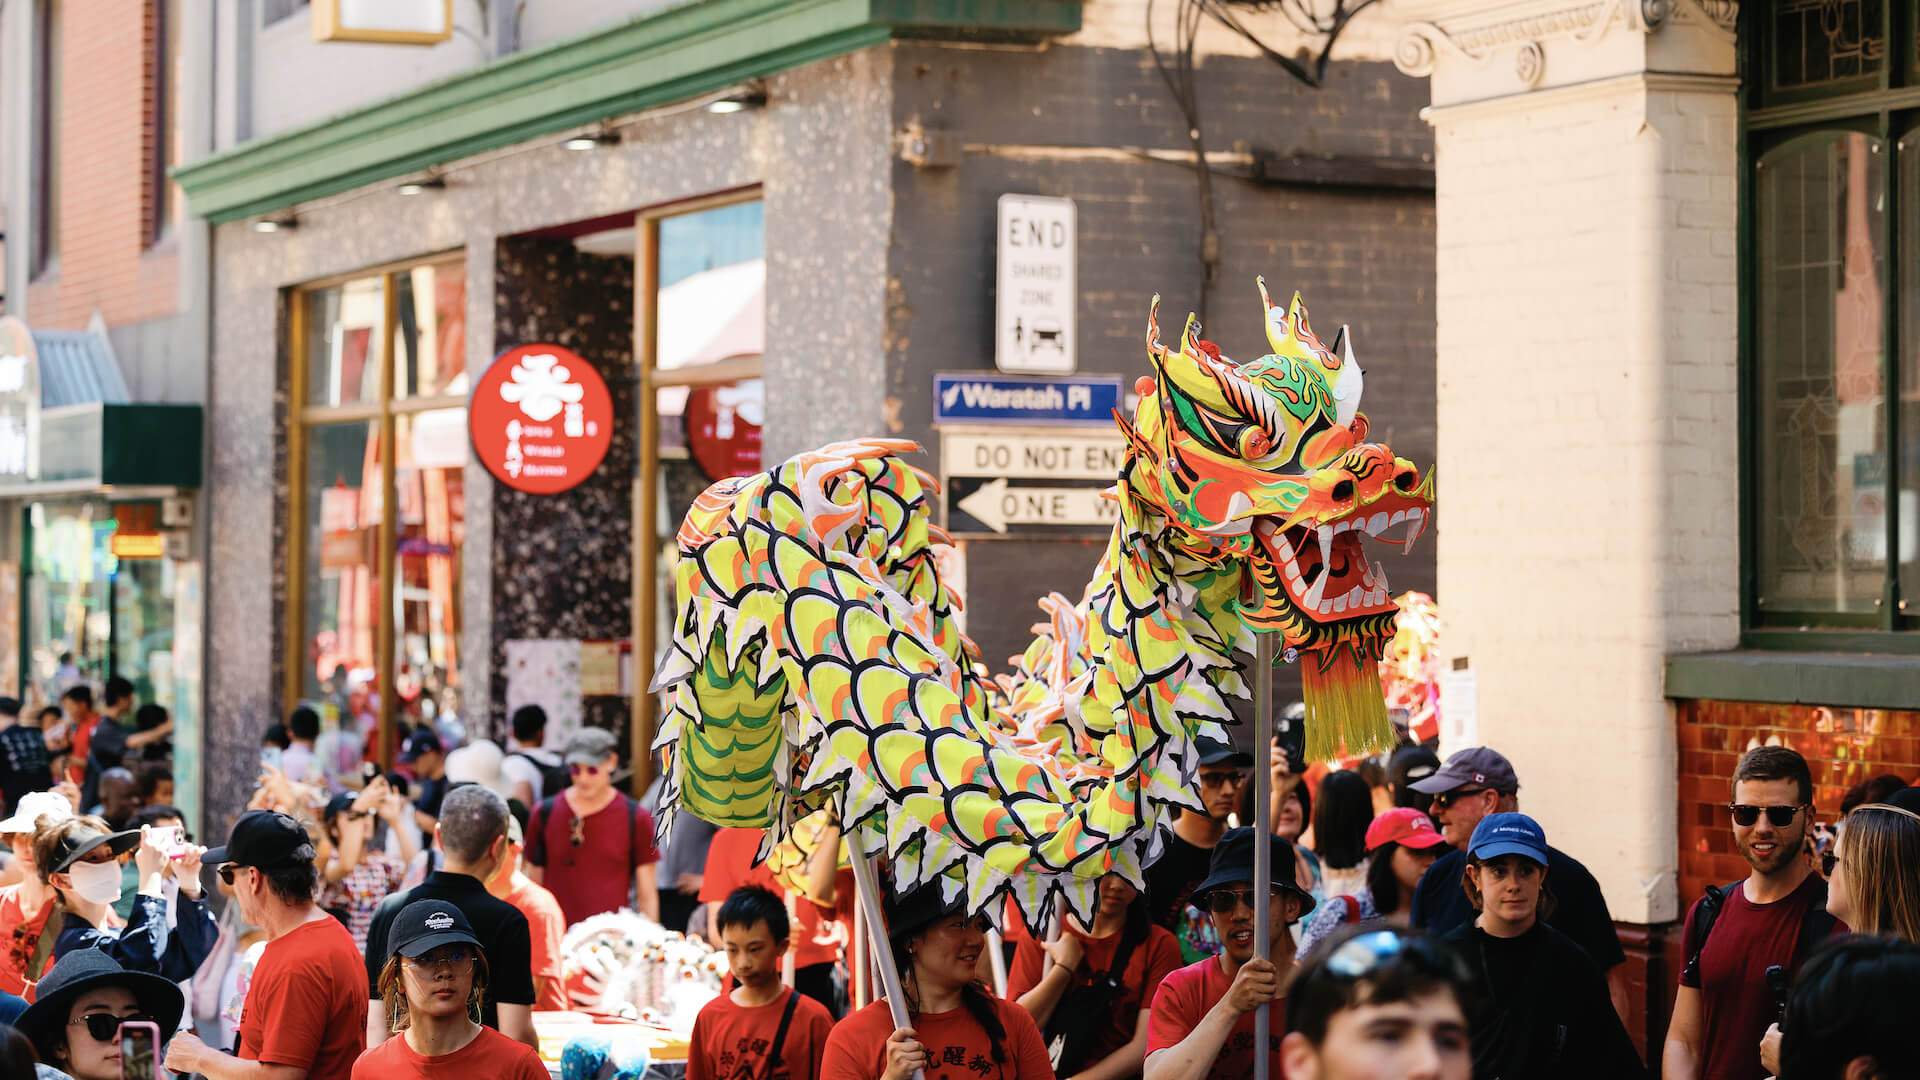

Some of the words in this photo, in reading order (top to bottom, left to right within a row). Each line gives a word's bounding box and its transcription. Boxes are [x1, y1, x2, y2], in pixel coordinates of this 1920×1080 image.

[1009, 218, 1065, 248] END
[1011, 262, 1062, 280] SHARED
[1020, 288, 1054, 306] ZONE
[961, 383, 1064, 410] Waratah
[1067, 385, 1092, 411] Pl
[975, 445, 1011, 469] DO
[1024, 447, 1071, 470] NOT
[1085, 448, 1125, 470] EN
[1002, 494, 1066, 518] ONE
[1094, 498, 1118, 517] W
